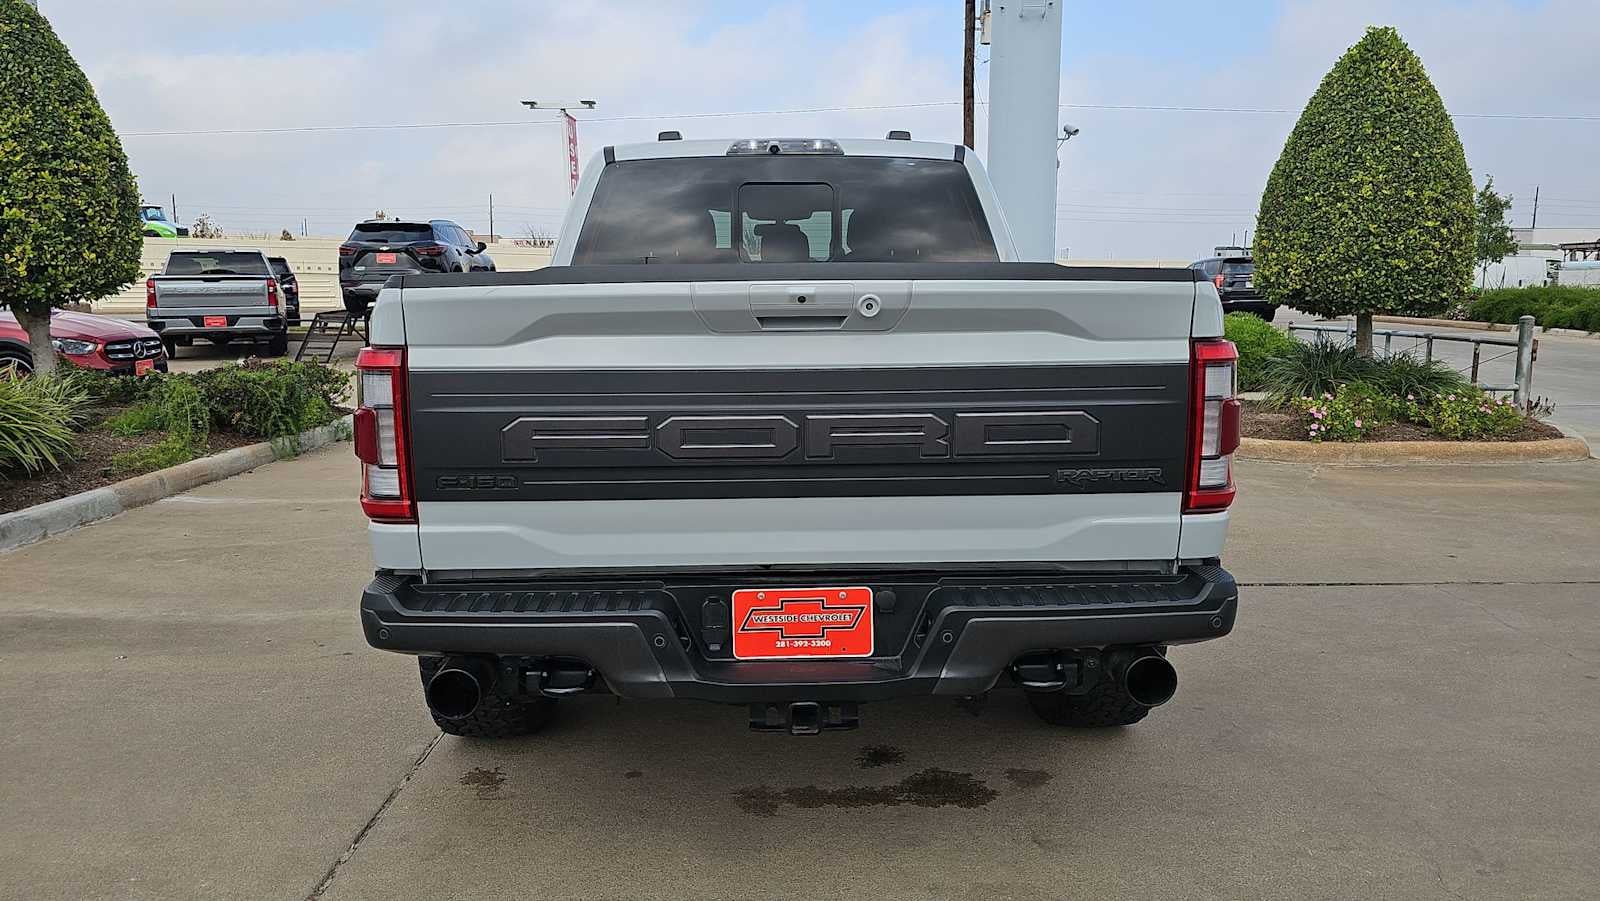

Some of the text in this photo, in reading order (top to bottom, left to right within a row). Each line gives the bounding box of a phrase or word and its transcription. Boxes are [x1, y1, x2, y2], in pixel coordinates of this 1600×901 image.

[501, 411, 1101, 463] FORD
[1056, 467, 1165, 489] RAPTOR
[753, 613, 852, 624] WESTSIDE CHEVROLET
